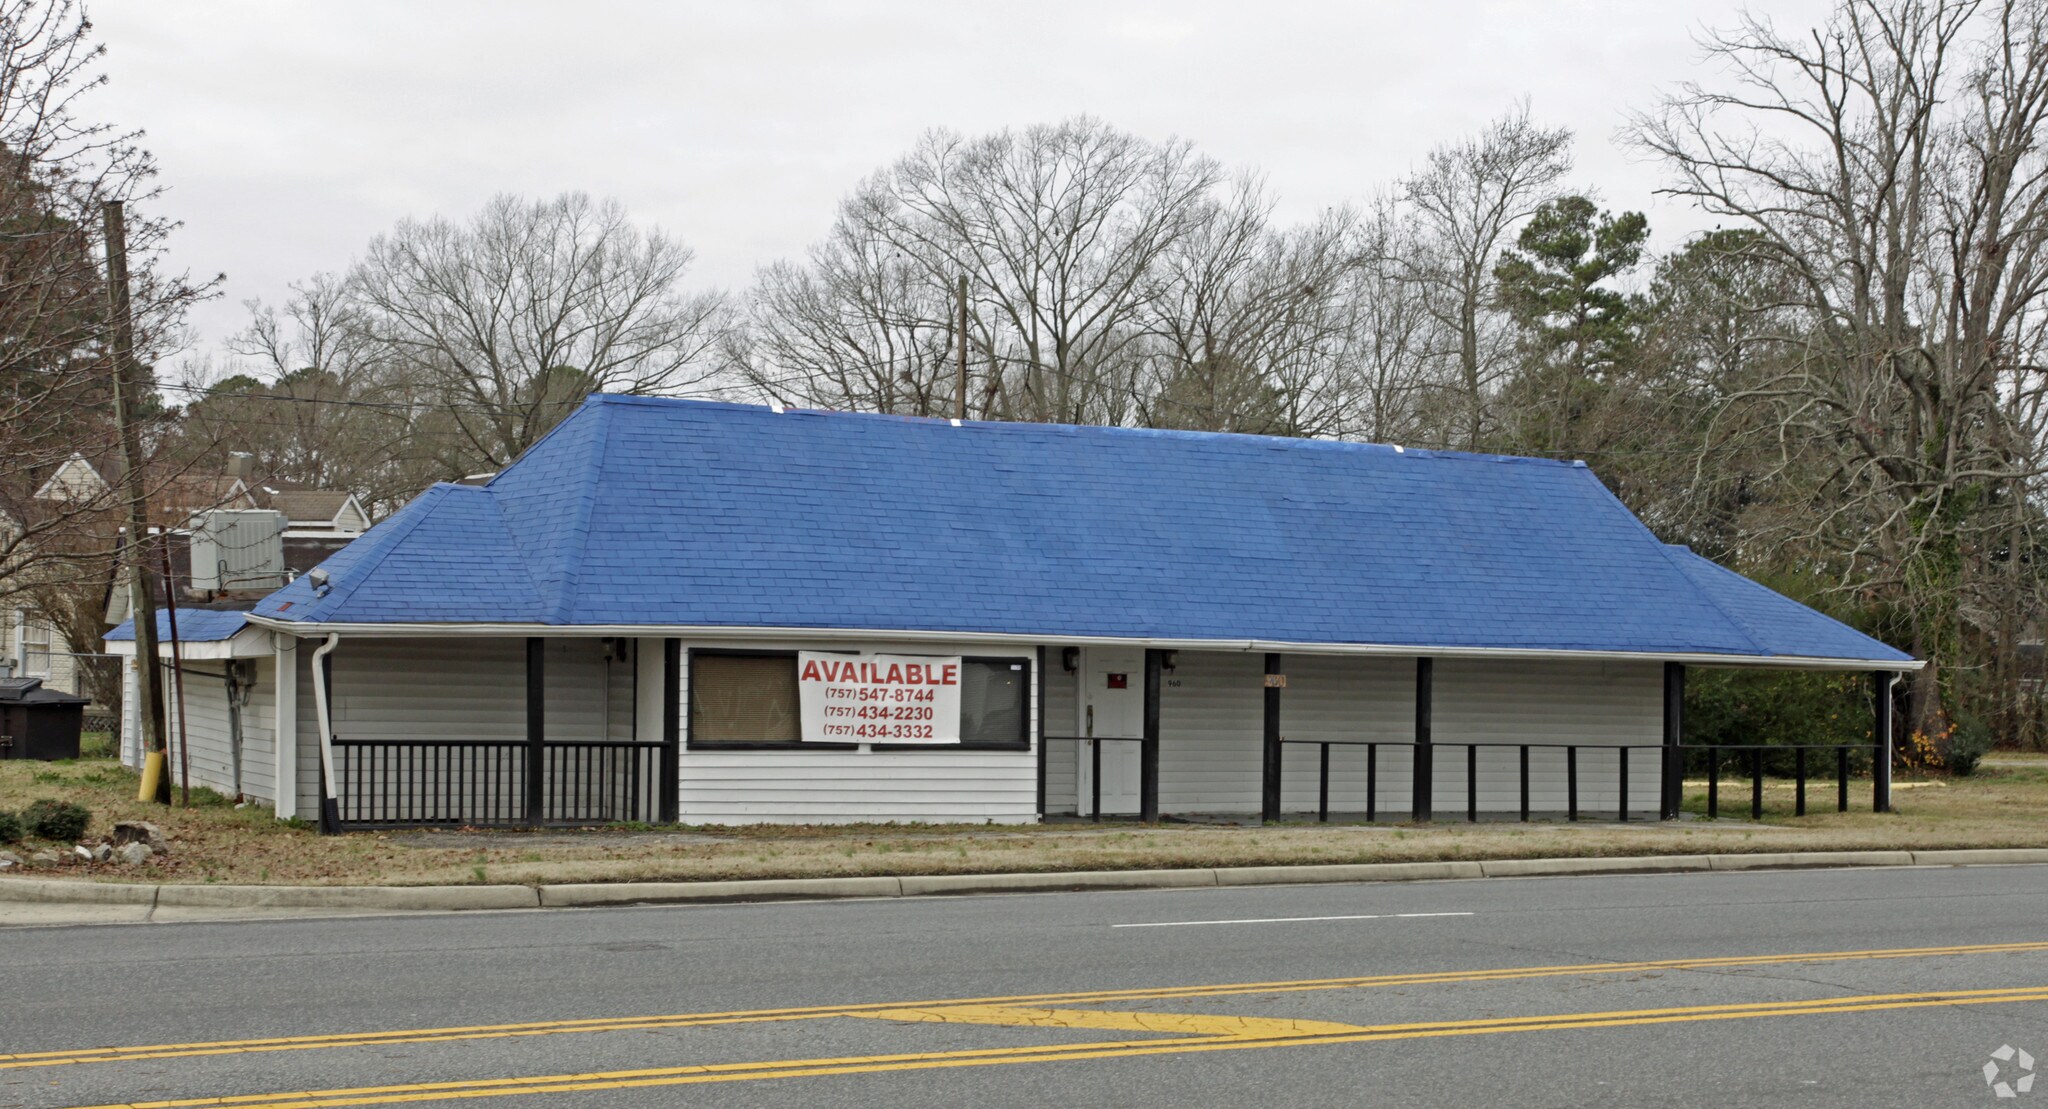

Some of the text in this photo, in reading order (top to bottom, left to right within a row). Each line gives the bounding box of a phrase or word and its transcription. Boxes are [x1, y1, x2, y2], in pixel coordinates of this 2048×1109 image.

[801, 660, 957, 685] AVAILABLE
[825, 687, 934, 702] (757) 547-8744
[824, 705, 934, 720] (757) 434-2230
[823, 723, 934, 739] (757) 434-3332
